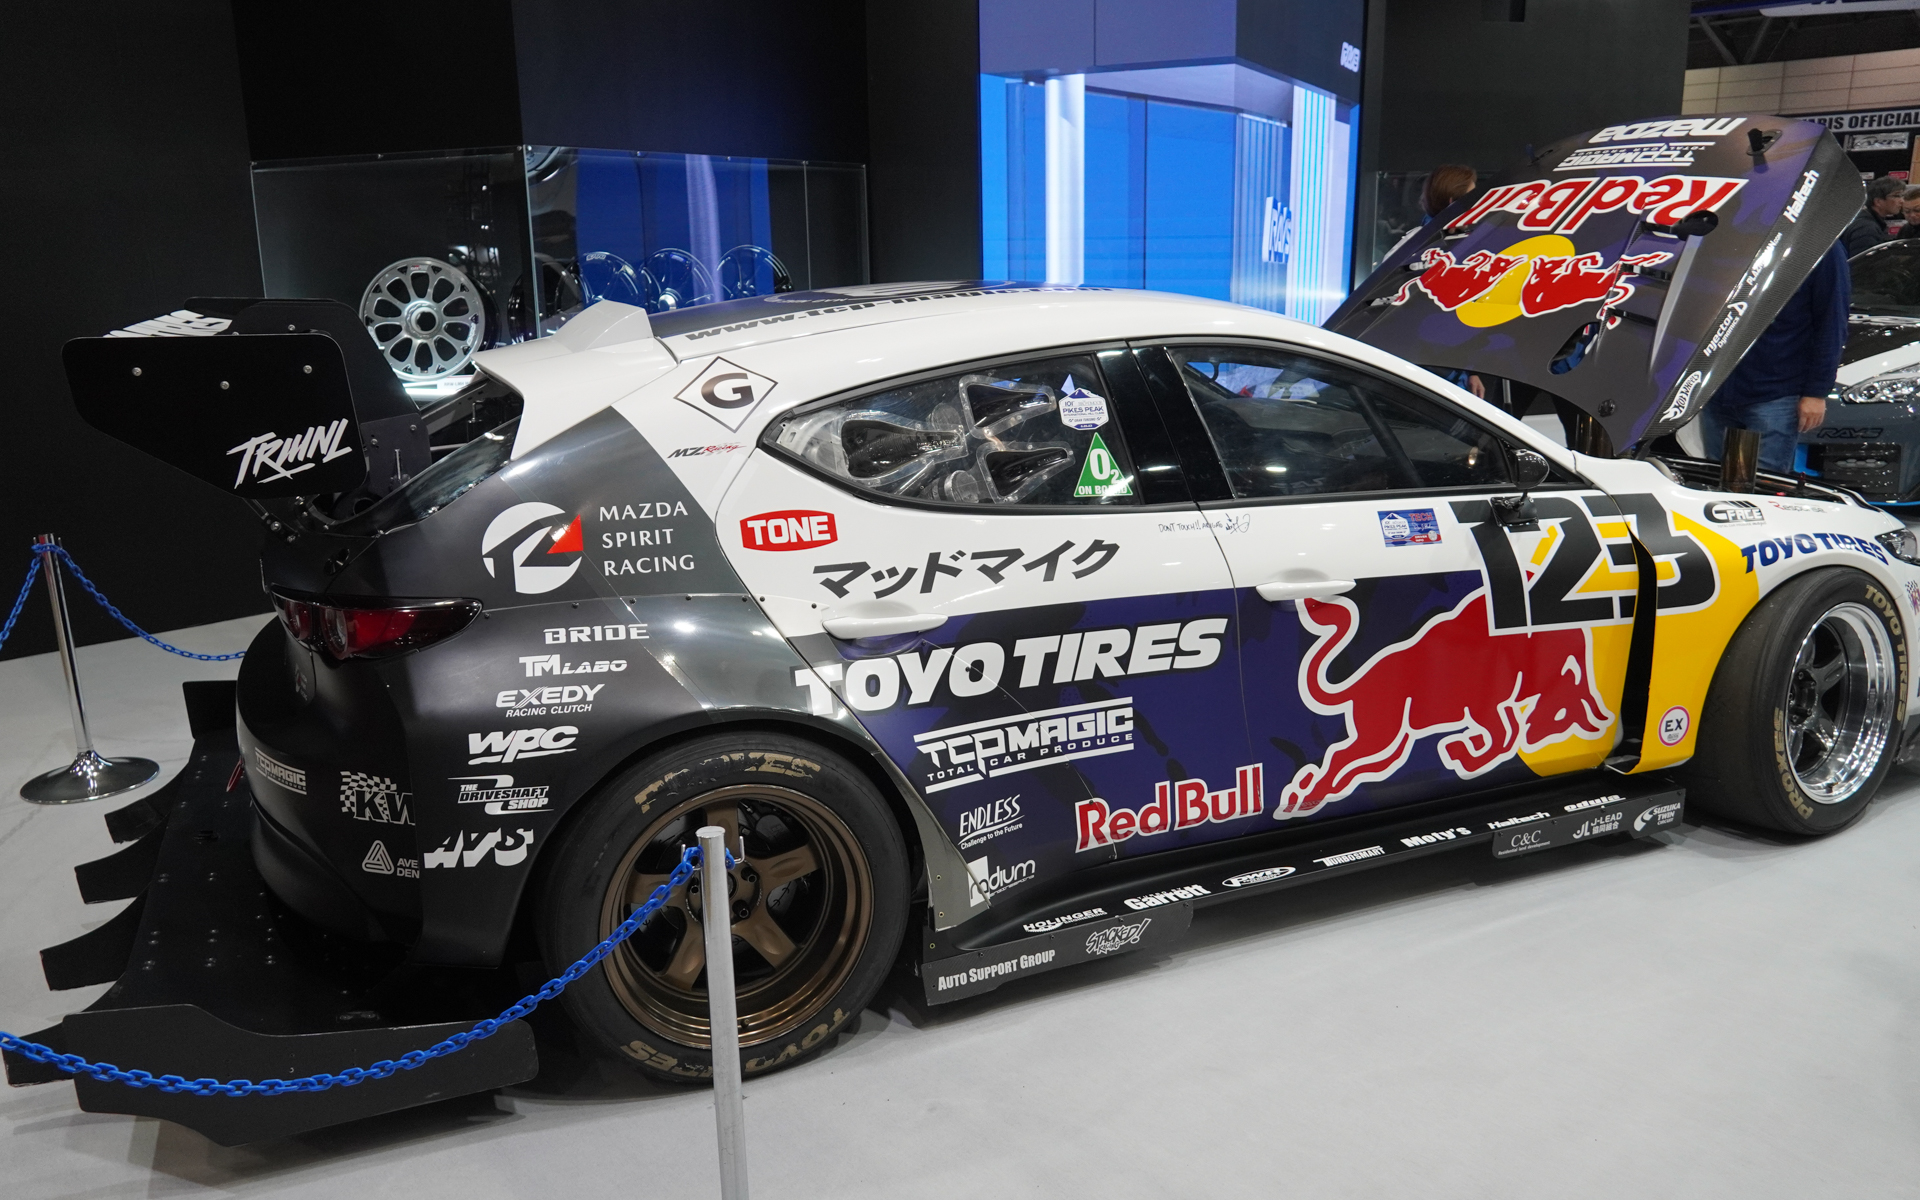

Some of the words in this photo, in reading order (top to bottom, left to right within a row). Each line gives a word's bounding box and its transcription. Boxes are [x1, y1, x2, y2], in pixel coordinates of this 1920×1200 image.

[1443, 177, 1601, 240] Bull
[1554, 175, 1750, 239] Red
[1783, 169, 1820, 223] Haltech
[701, 373, 755, 409] G
[1817, 427, 1883, 439] RAYS
[1078, 485, 1092, 495] ON
[599, 500, 689, 522] MAZDA
[1409, 512, 1433, 522] TECH
[601, 528, 674, 549] SPIRIT
[748, 516, 832, 546] TONE
[602, 554, 696, 577] RACING
[1448, 493, 1716, 630] 123
[1741, 534, 1818, 574] TOYO
[1812, 533, 1890, 566] TIRES
[813, 539, 1121, 599] マッドマイク
[543, 623, 650, 645] BRIDE
[1865, 585, 1902, 636] TOYO
[1896, 637, 1908, 722] TIRES
[795, 642, 1005, 716] TOYO
[1013, 618, 1228, 688] TIRES
[495, 683, 606, 709] EXEDY
[506, 707, 547, 718] RACING
[551, 704, 593, 715] CLUTCH
[1664, 717, 1684, 733] EX
[927, 764, 975, 782] TOTAL
[989, 751, 1027, 767] CAR
[1039, 733, 1134, 757] PRODUCE
[1773, 706, 1814, 820] PROXES
[459, 786, 549, 803] DRIVESHAFT
[507, 797, 549, 810] SHOP
[959, 794, 1021, 837] ENDLESS
[1075, 780, 1171, 854] Red
[1174, 763, 1263, 832] Bull
[1487, 811, 1551, 830] Haltech
[1590, 812, 1623, 827] J-LEAD
[1652, 802, 1682, 816] SUZUKA
[1656, 811, 1675, 821] TWIN
[960, 837, 987, 850] Challenge
[994, 829, 1004, 837] the
[1004, 823, 1023, 834] Future
[1400, 826, 1472, 848] Moty's
[1510, 830, 1541, 848] C&C
[1313, 846, 1386, 867] TURBOSMART
[1124, 884, 1212, 911] Garrett
[1023, 907, 1104, 932] HOLINGER
[1085, 917, 1152, 955] STACKED!
[744, 1007, 851, 1073] TOYO
